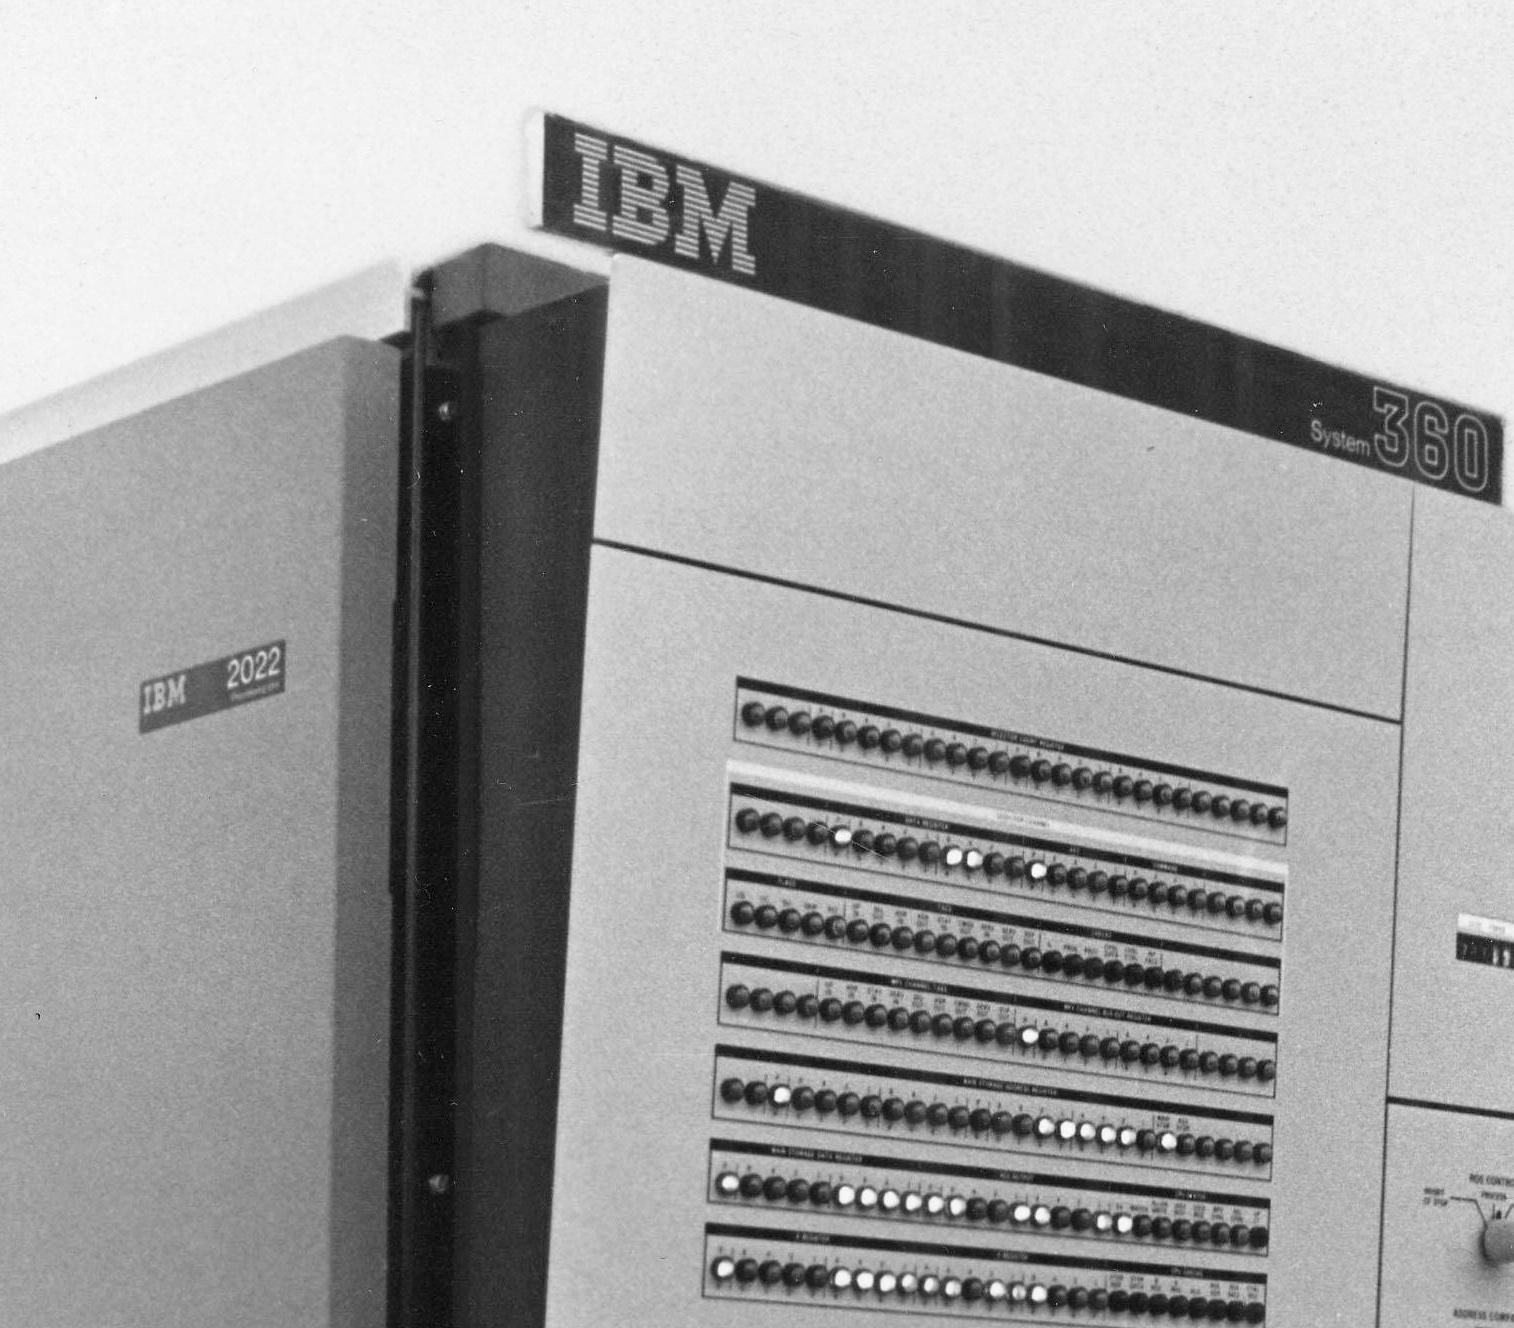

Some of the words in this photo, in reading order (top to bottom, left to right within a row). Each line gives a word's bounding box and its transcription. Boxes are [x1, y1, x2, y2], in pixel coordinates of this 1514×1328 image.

[574, 131, 757, 276] IBM
[1309, 419, 1371, 457] System
[1372, 385, 1489, 493] 360
[143, 674, 187, 714] IBM
[226, 645, 281, 689] 2022
[1453, 1308, 1488, 1320] ADDRESS
